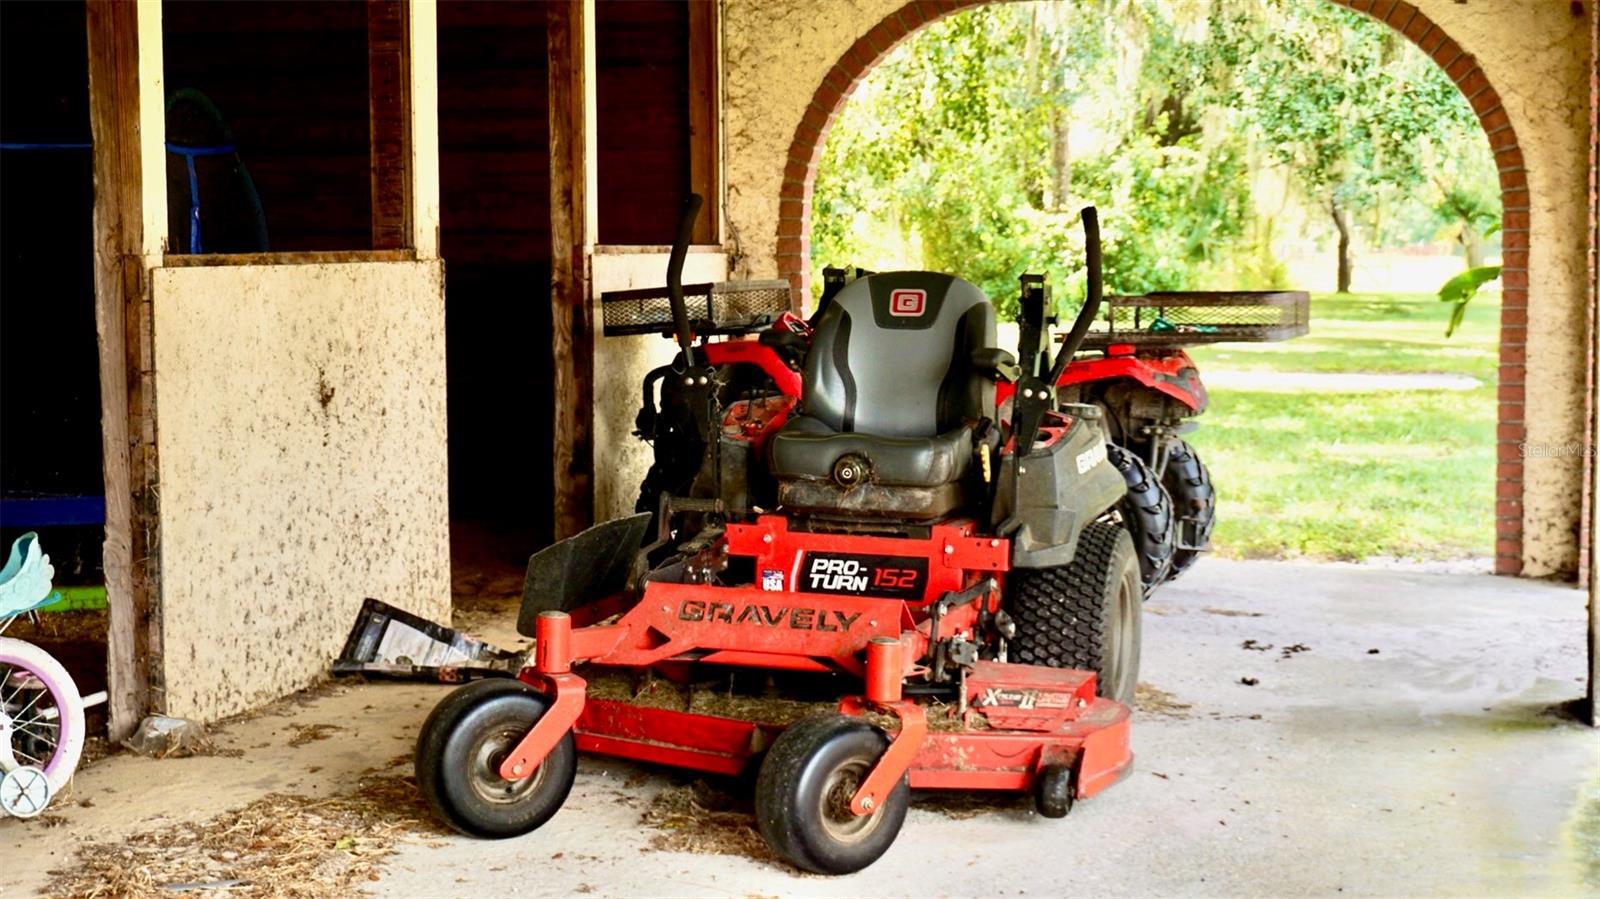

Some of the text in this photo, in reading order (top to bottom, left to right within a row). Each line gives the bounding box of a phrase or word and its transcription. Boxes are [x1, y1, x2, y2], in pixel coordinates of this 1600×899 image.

[811, 559, 867, 576] PRO-
[809, 573, 869, 591] TURN
[874, 568, 917, 588] 152
[679, 600, 861, 632] GRAVELY
